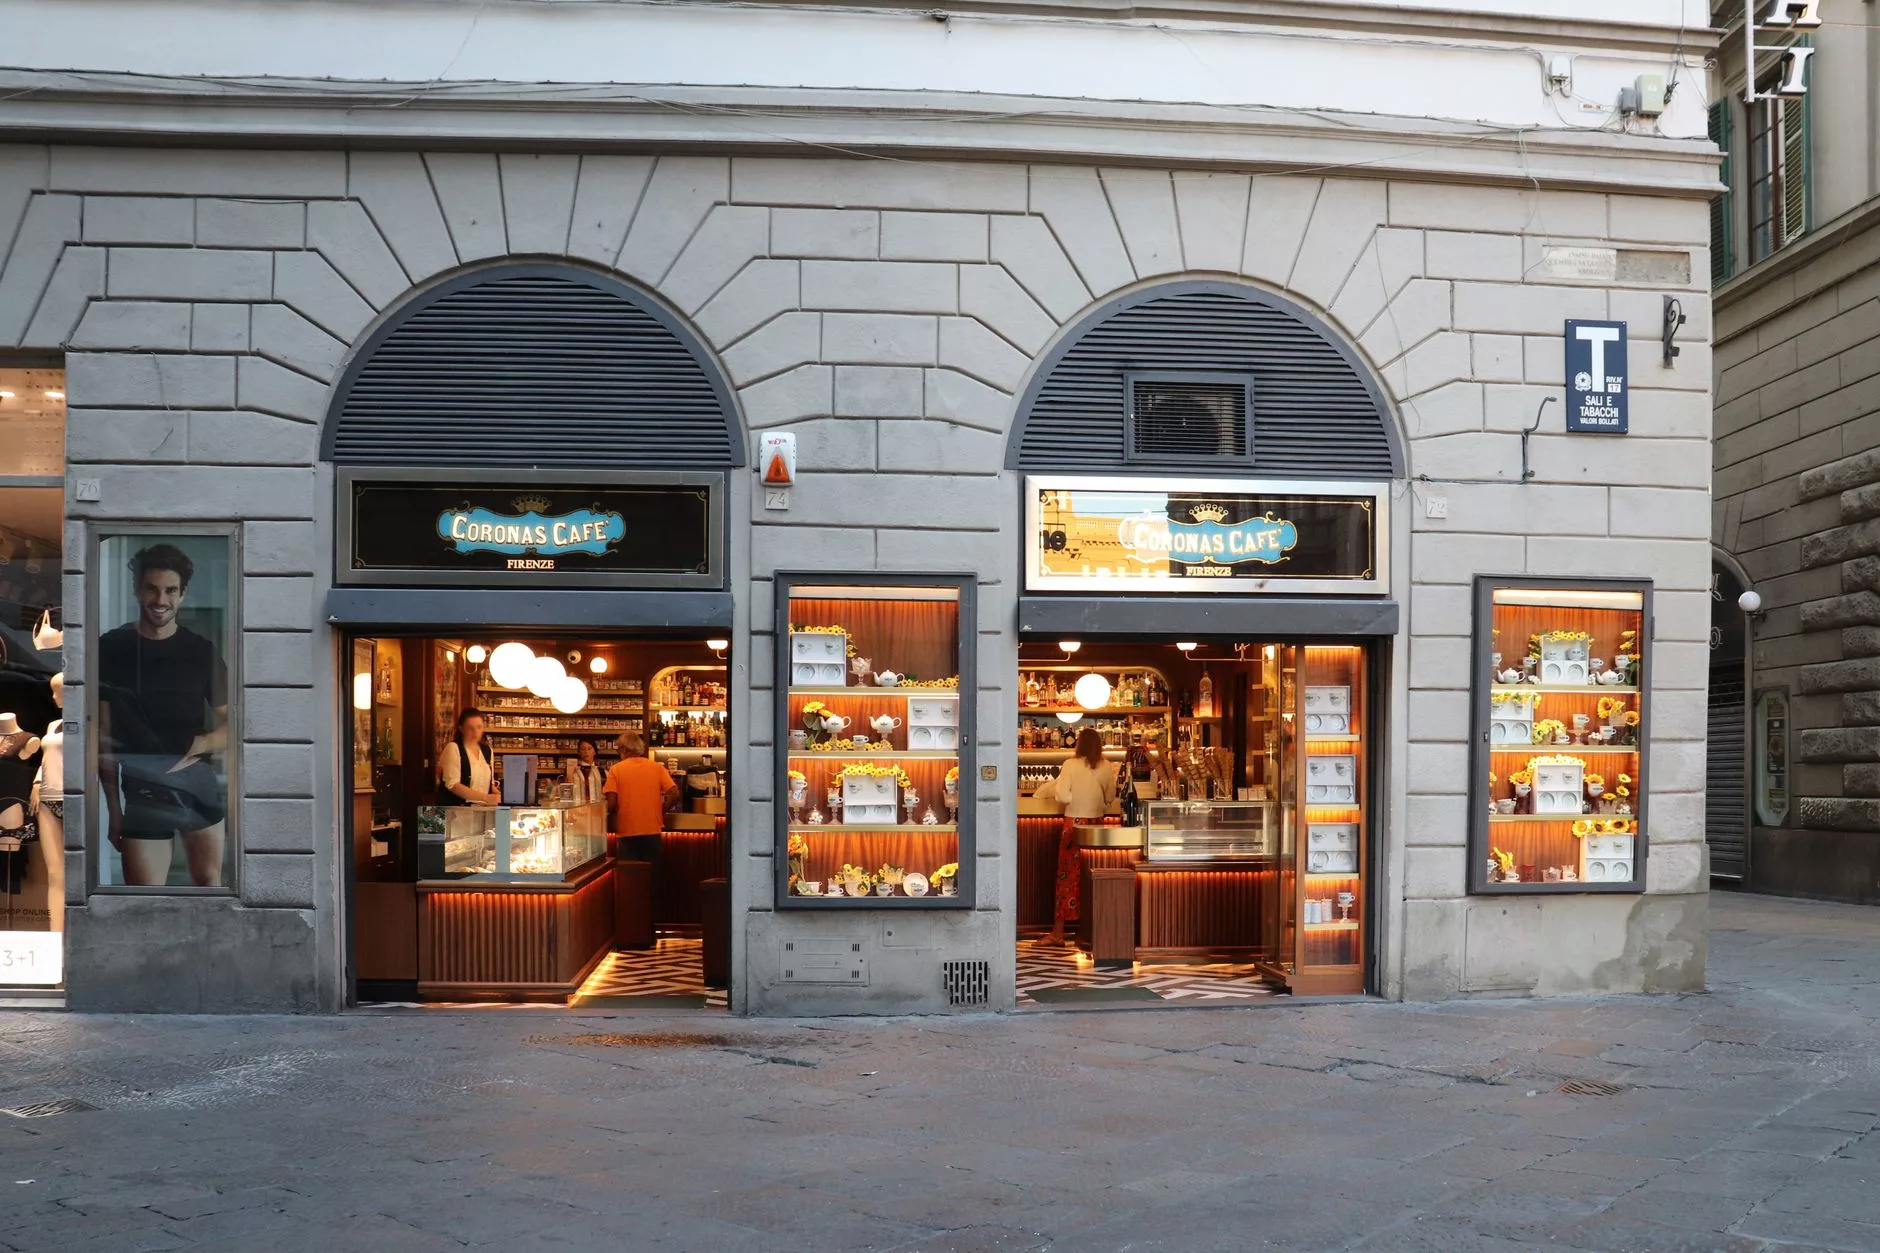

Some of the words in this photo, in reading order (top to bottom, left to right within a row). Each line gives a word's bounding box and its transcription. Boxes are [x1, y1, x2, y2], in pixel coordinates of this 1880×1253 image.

[1575, 326, 1620, 392] T
[1585, 395, 1603, 406] SALI
[1606, 396, 1613, 406] E
[1579, 406, 1619, 418] TABACCHI
[1580, 417, 1598, 425] VALORI
[767, 491, 786, 507] 74
[452, 515, 548, 546] CORONAS
[1134, 523, 1224, 554] CORONAS
[507, 559, 555, 570] FIRENZE
[1186, 566, 1232, 577] FIRENZE
[22, 908, 51, 916] ONLINE
